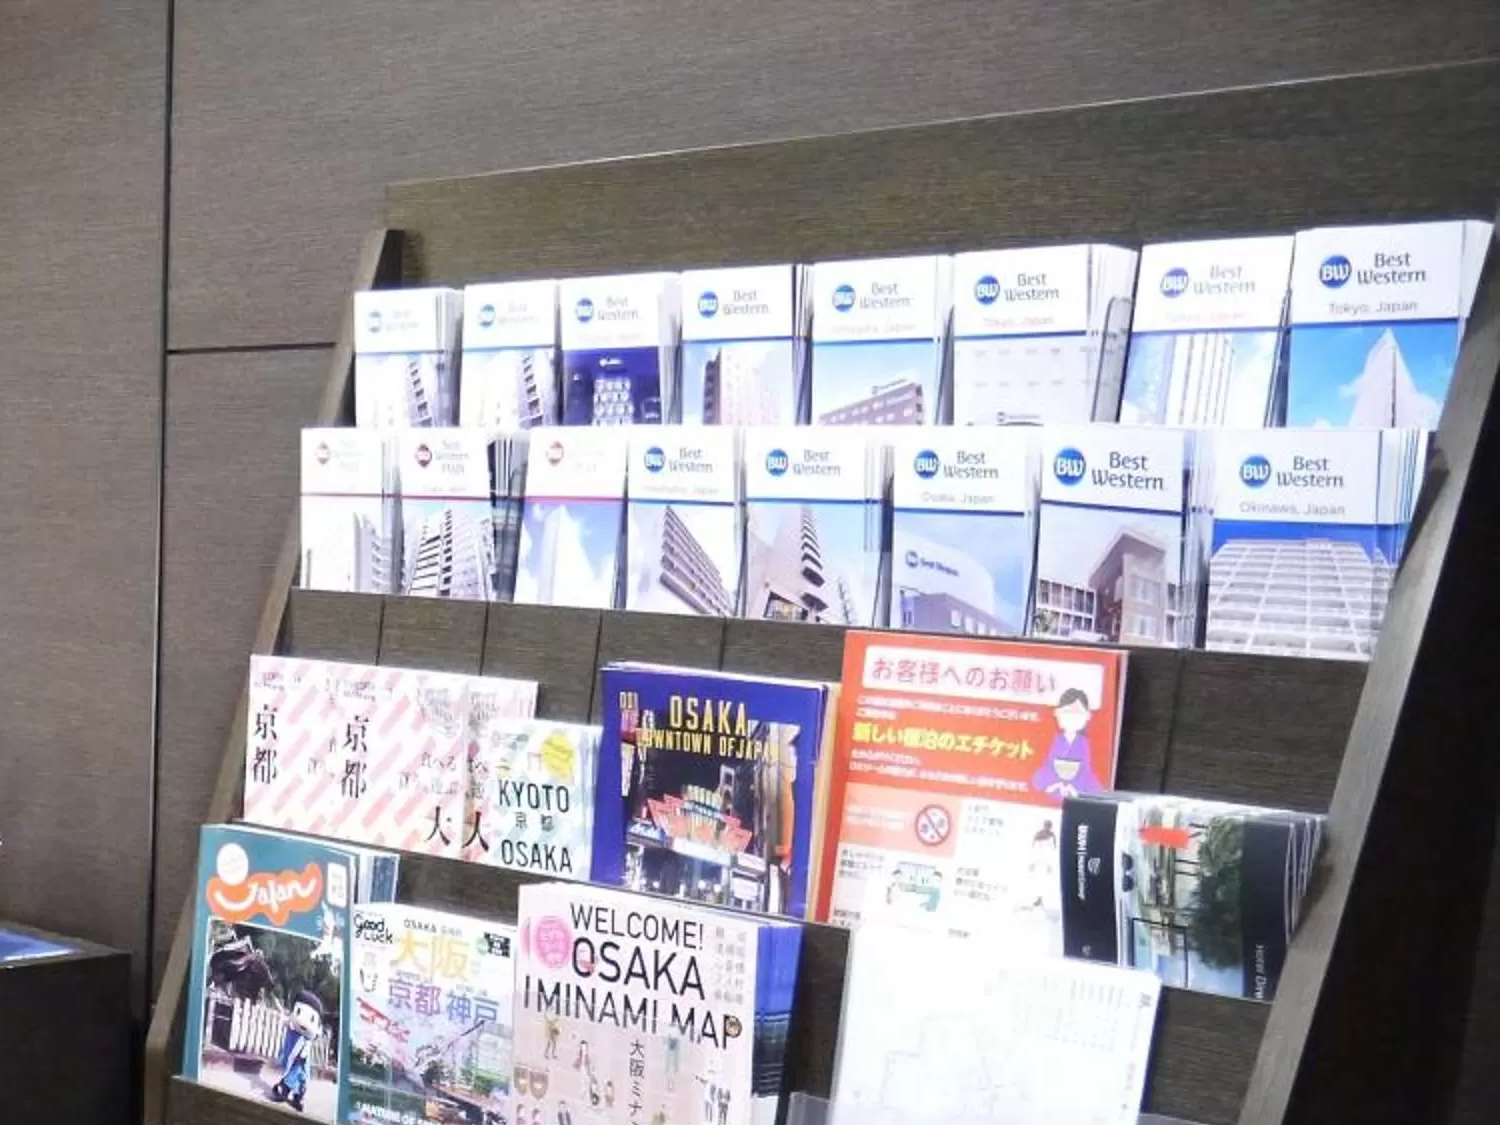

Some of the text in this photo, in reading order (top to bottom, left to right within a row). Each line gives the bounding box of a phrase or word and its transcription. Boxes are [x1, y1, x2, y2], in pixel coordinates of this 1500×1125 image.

[1374, 252, 1411, 268] Best
[1017, 273, 1047, 287] Best
[1209, 265, 1242, 280] Best
[1357, 268, 1427, 286] Western
[871, 282, 899, 296] Best
[1004, 287, 1059, 303] Western
[1193, 279, 1256, 295] Western
[733, 289, 757, 302] Best
[859, 295, 910, 309] Western
[722, 302, 770, 316] Western
[1375, 300, 1418, 314] Japan
[678, 447, 704, 460] Best
[803, 449, 830, 463] Best
[956, 450, 985, 465] Best
[1108, 451, 1149, 471] Best
[669, 460, 714, 474] Western
[792, 462, 841, 477] Western
[1293, 455, 1329, 471] Best
[943, 465, 999, 481] Western
[1091, 468, 1165, 491] Western
[1276, 472, 1344, 489] Western
[1303, 502, 1346, 517] Japan
[871, 656, 1057, 694] お客様へのお願い
[669, 694, 747, 737] OSAKA
[252, 702, 279, 784] 京都
[719, 735, 735, 757] OF
[736, 736, 780, 762] JAPAN
[341, 712, 370, 799] 京都
[498, 780, 570, 814] KYOTO
[500, 838, 574, 875] OSAKA
[213, 876, 318, 913] Jalan
[570, 901, 704, 951] WELCOME!
[389, 931, 471, 982] 大阪
[571, 936, 706, 1001] OSAKA
[388, 977, 500, 1025] 京都 神戸
[536, 978, 743, 1051] MINAMI MAP
